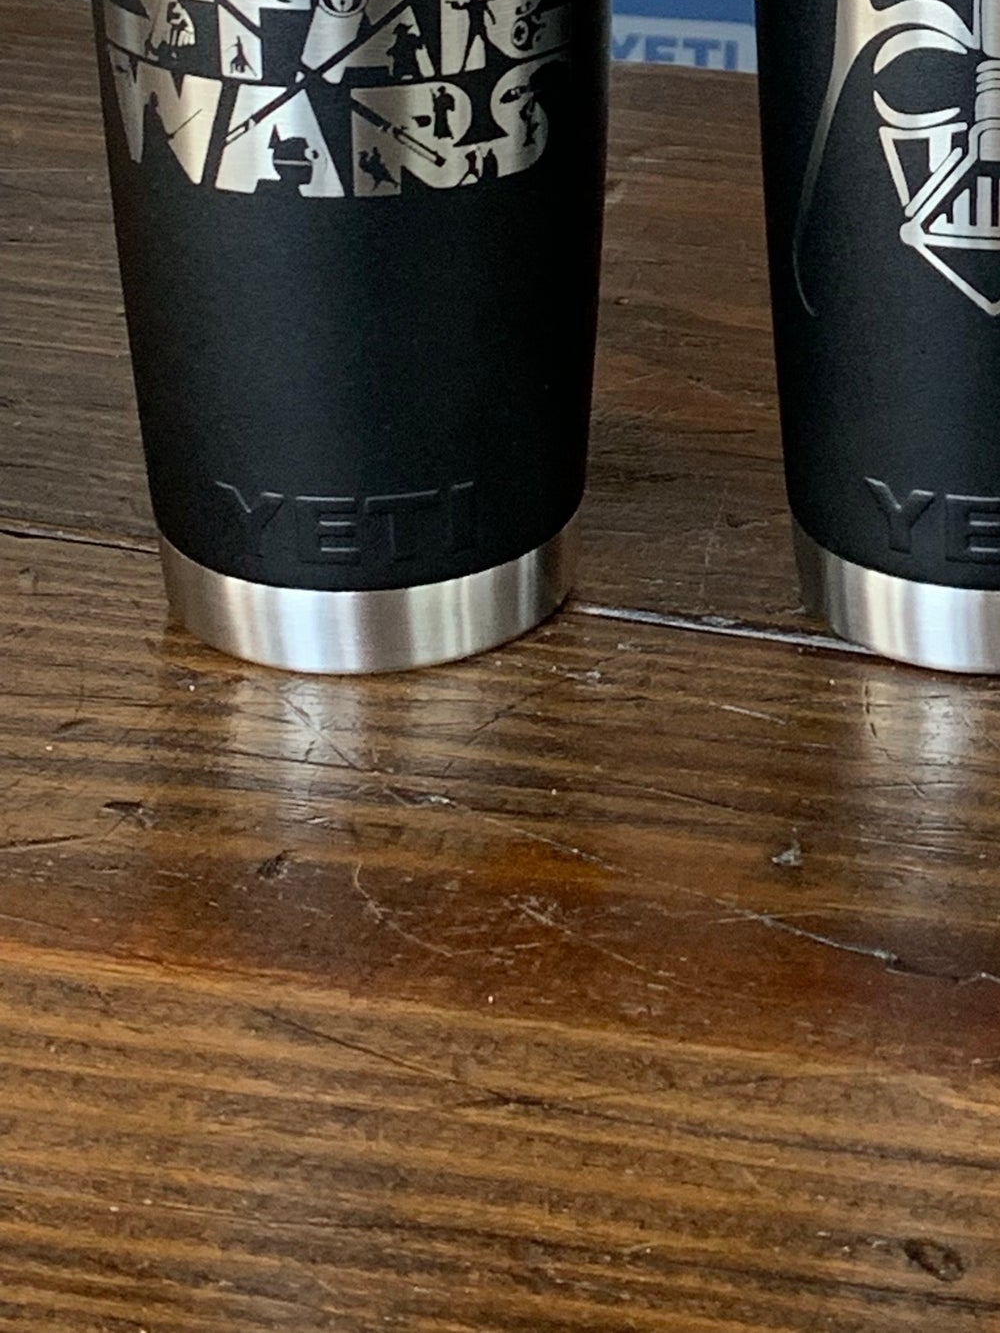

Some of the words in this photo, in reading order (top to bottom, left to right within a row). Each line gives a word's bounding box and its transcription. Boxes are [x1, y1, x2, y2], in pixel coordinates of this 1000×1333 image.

[612, 32, 739, 70] YETI
[108, 50, 566, 198] WARS
[214, 478, 476, 564] YETI
